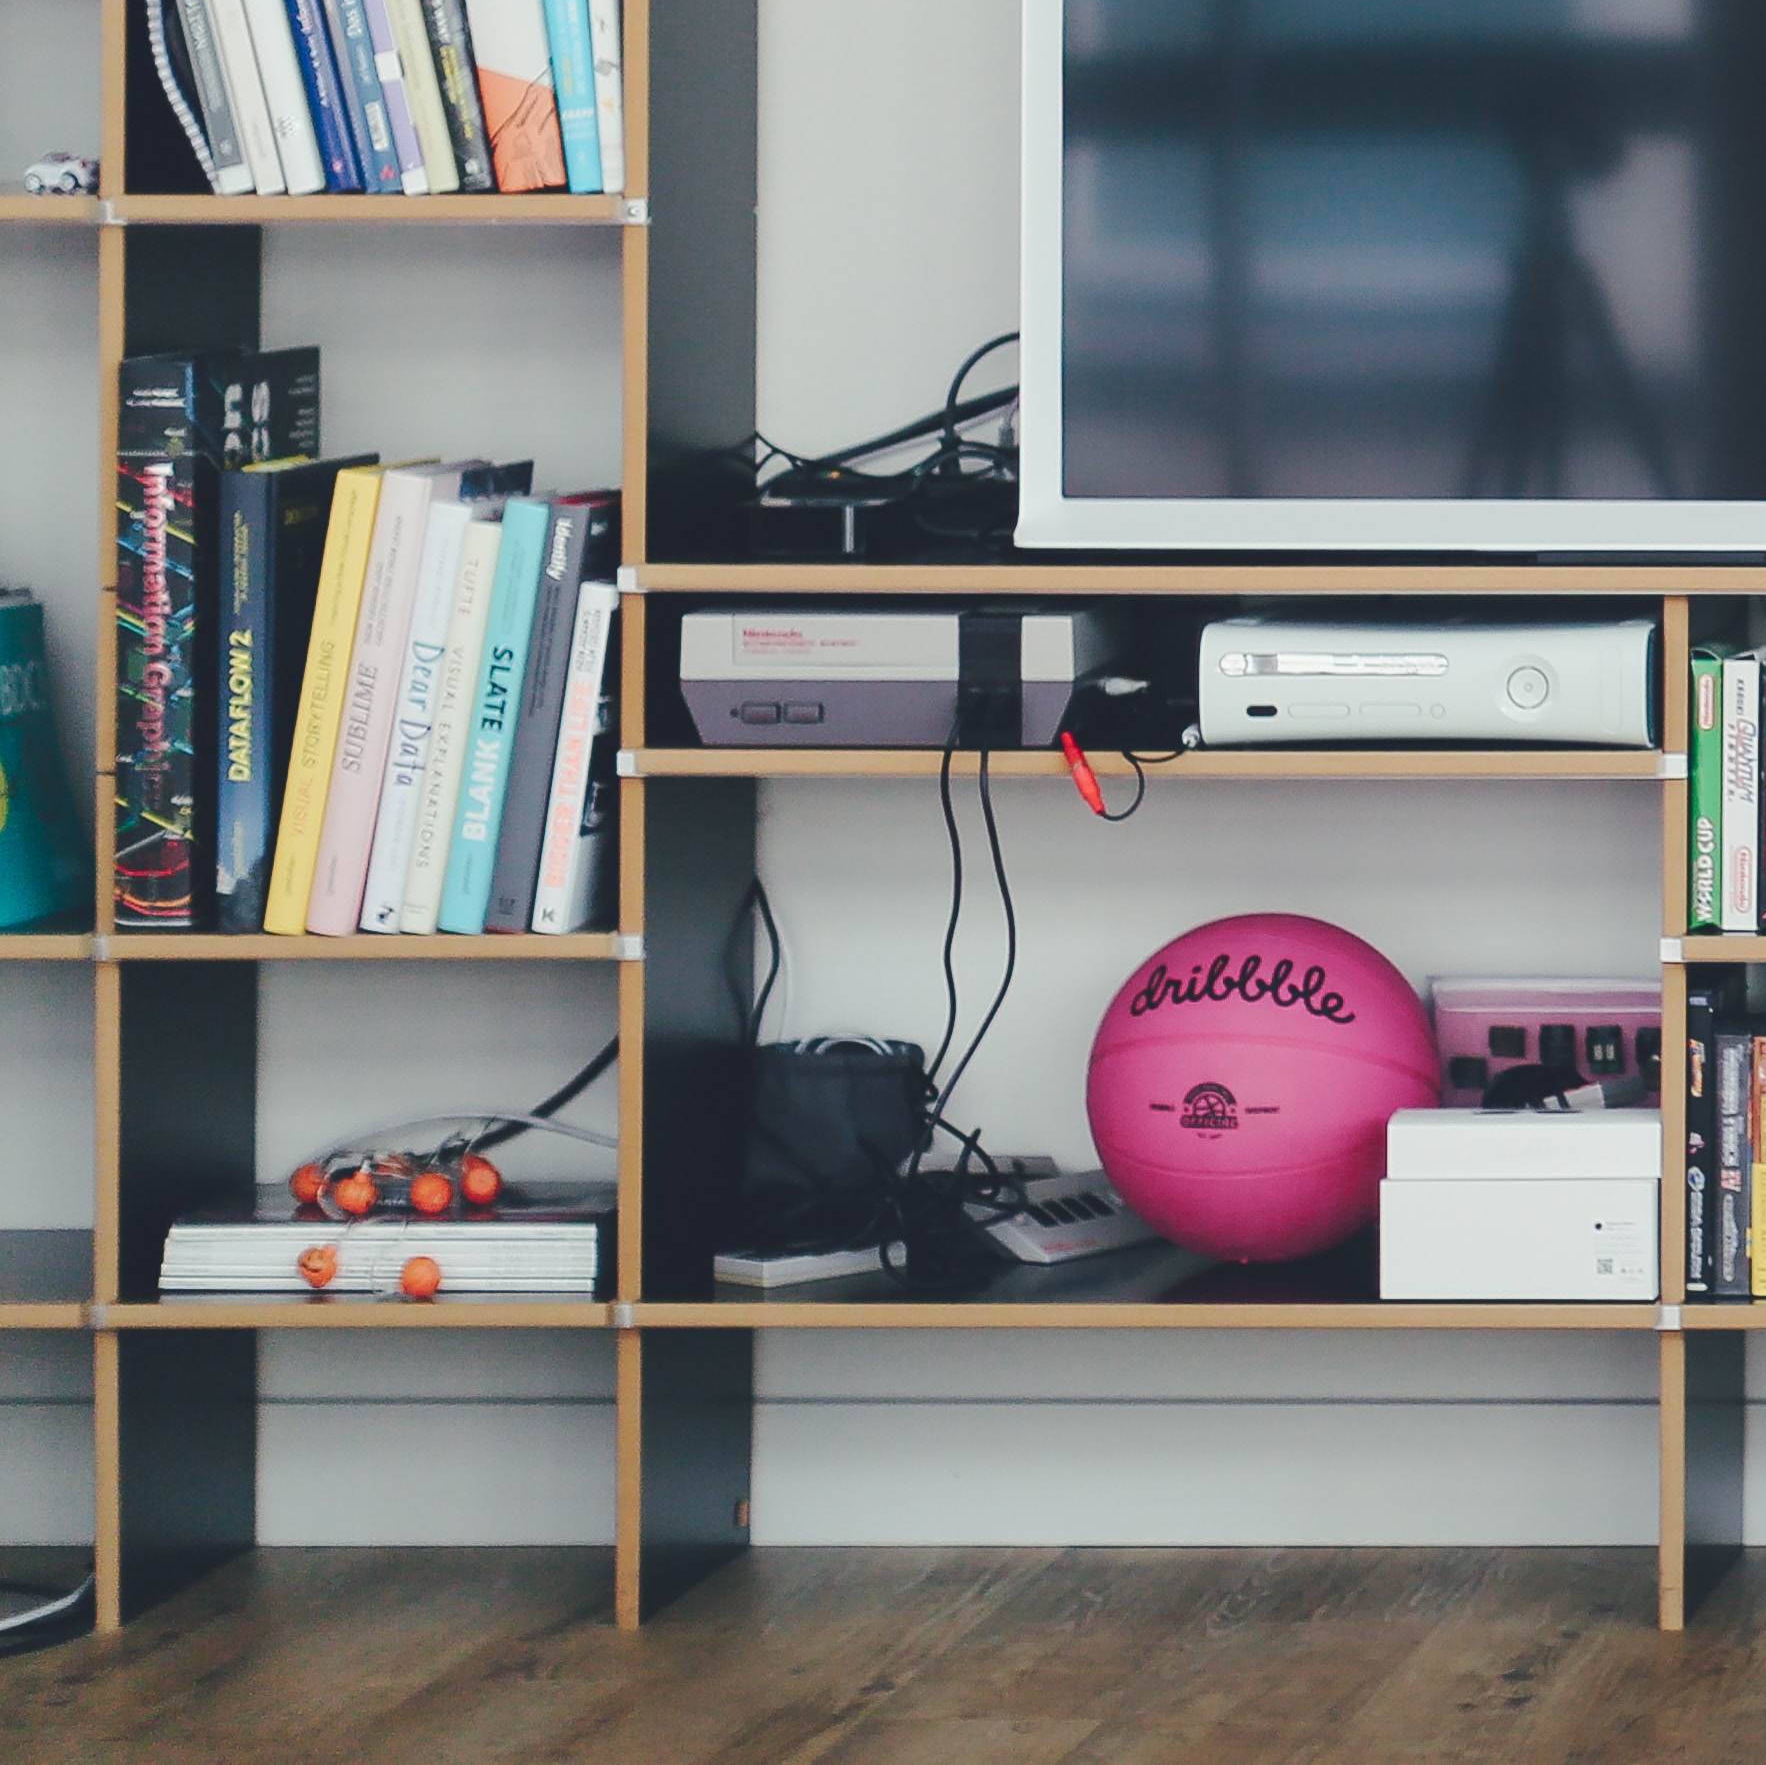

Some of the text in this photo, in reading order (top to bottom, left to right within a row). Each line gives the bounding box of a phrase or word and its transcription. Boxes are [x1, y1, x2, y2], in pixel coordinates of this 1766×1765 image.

[229, 630, 252, 781] DATAFLOW 2
[480, 645, 514, 731] SLATE
[462, 739, 500, 843] BLANK
[1130, 953, 1356, 1025] dribbble
